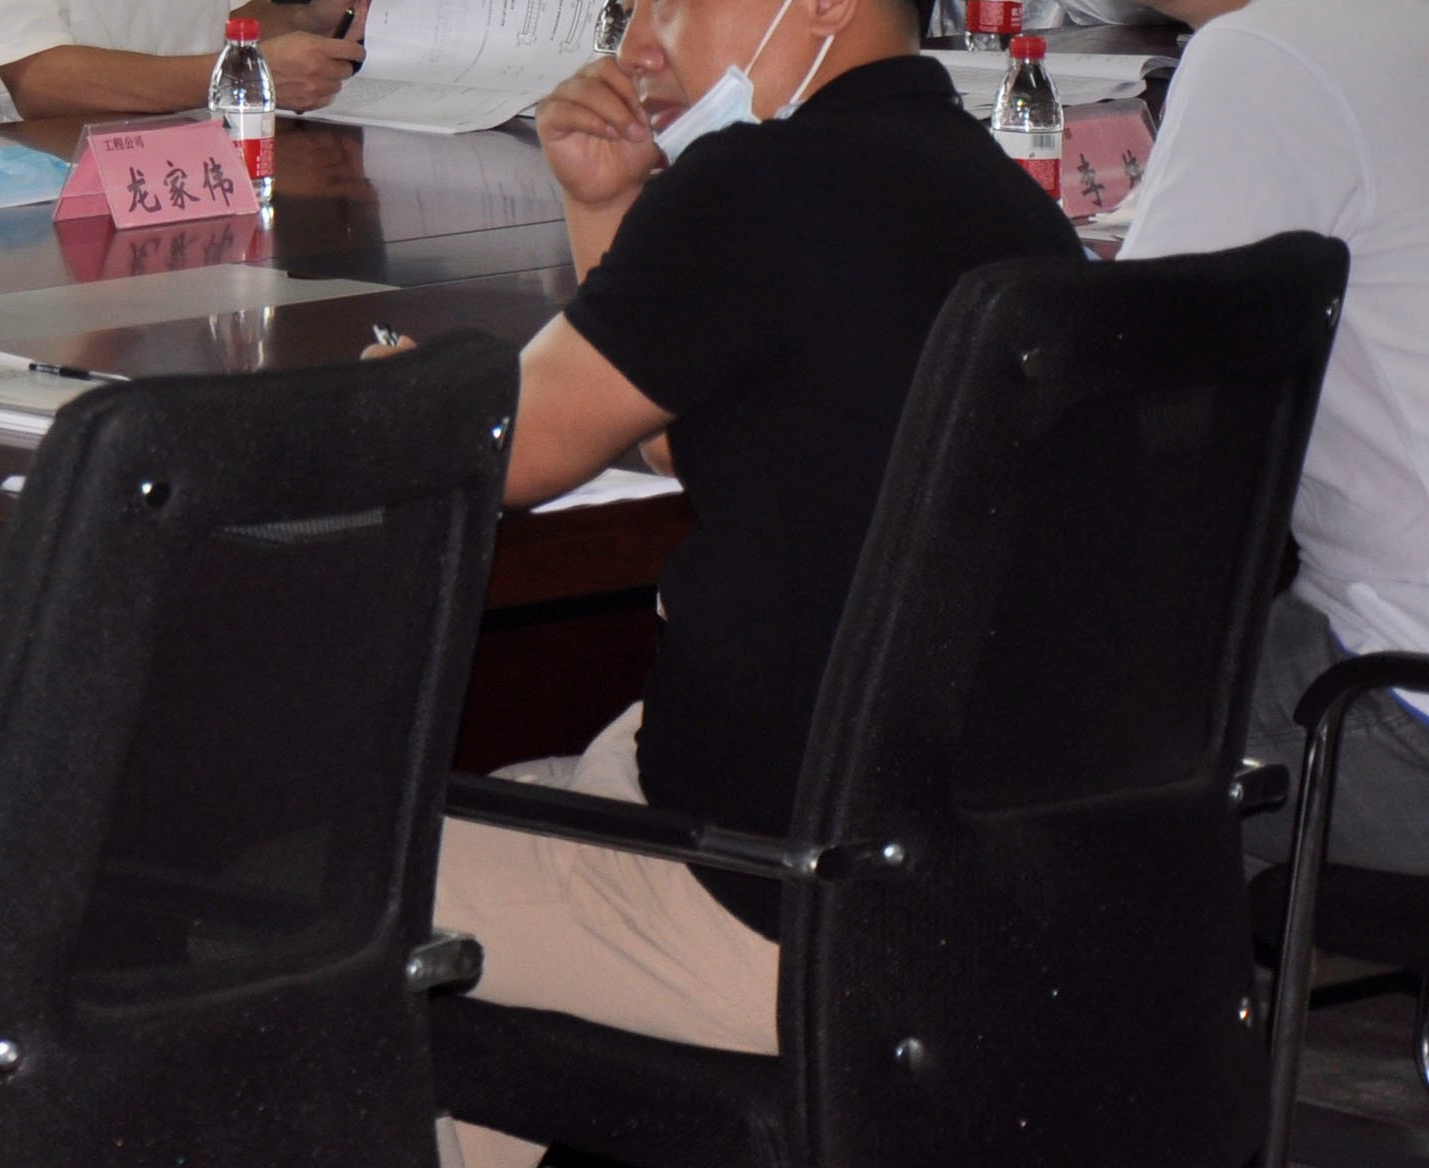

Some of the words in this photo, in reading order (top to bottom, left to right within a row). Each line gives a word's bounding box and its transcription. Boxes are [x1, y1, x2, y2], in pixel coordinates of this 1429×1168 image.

[104, 135, 144, 152] 工程公司
[126, 156, 234, 213] 龙家伟
